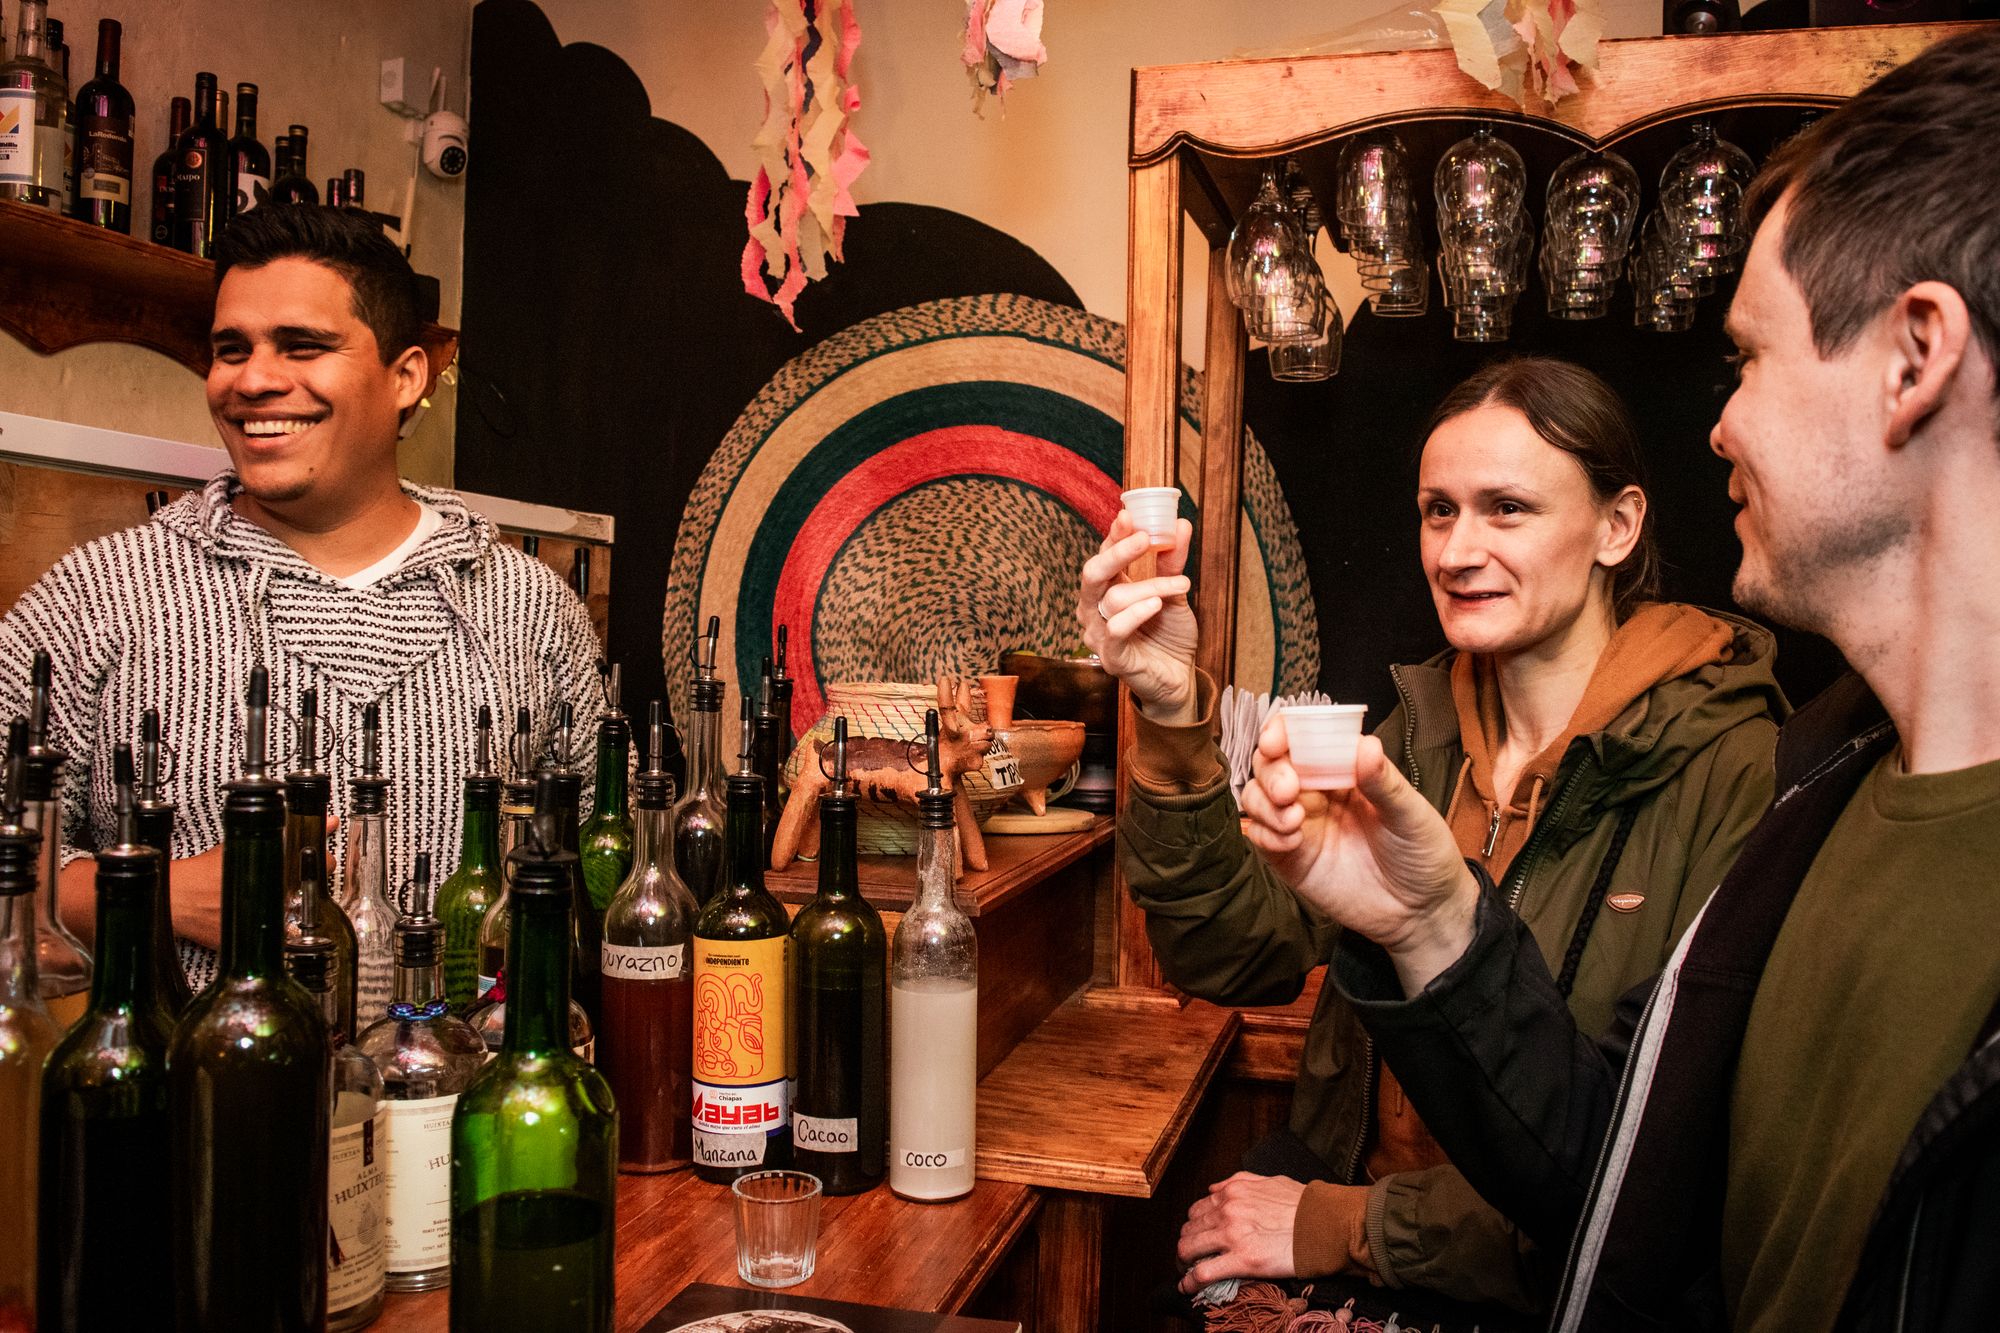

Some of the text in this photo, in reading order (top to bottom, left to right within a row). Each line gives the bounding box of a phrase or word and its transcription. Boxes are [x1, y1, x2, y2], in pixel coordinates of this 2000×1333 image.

[602, 947, 678, 972] Durazno
[797, 1119, 849, 1144] Cacao
[694, 1136, 757, 1162] Manzana
